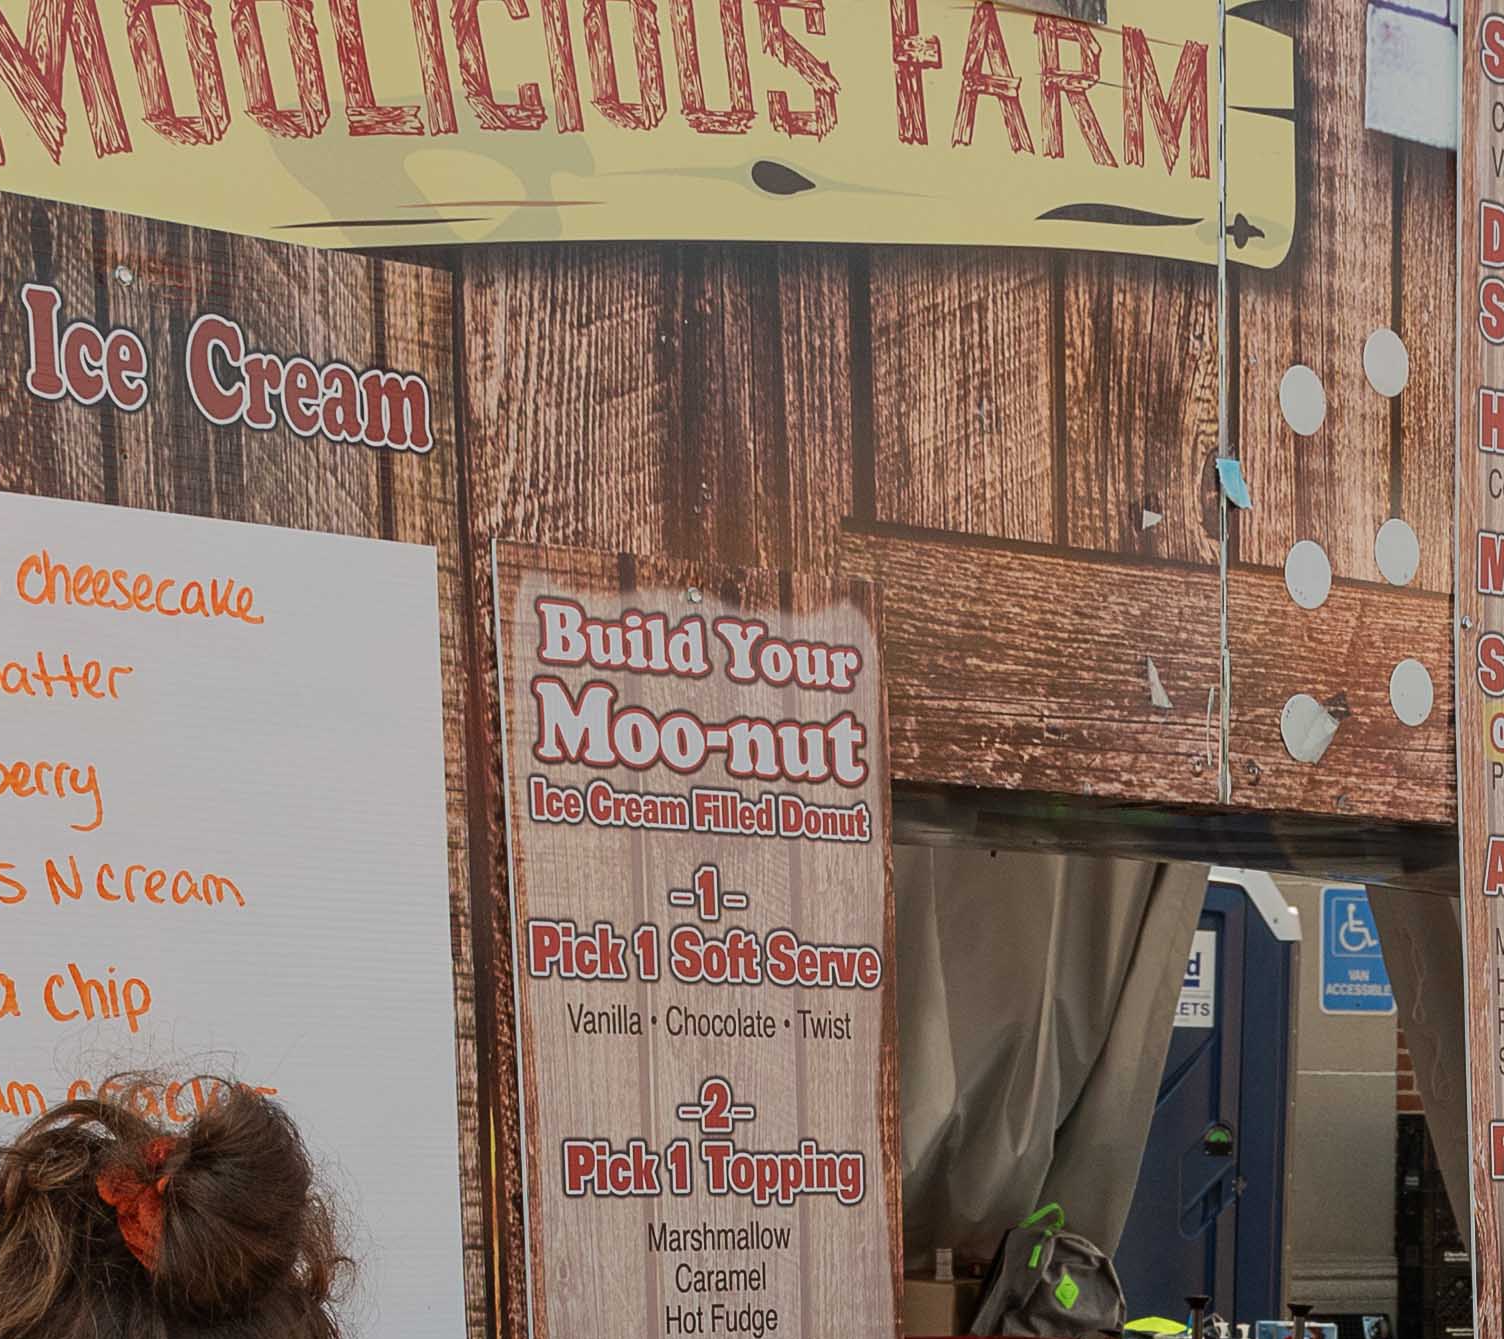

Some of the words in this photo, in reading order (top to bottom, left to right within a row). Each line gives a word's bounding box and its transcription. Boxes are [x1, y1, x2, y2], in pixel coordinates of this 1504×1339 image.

[898, 0, 1211, 179] FARM
[21, 283, 147, 411] Ice
[186, 314, 433, 454] Cream
[536, 595, 707, 677] Build
[717, 618, 861, 692] Your
[532, 676, 868, 788] Moo-nut
[529, 777, 581, 822] Ice
[588, 777, 689, 830] Cream
[692, 788, 776, 837] Filled
[781, 794, 871, 843] Donut
[47, 856, 83, 899] N
[95, 864, 245, 909] cream
[528, 921, 627, 979] Pick
[634, 926, 659, 980] 1
[671, 925, 761, 984] Soft
[767, 931, 881, 989] Serve
[1349, 970, 1369, 981] VAN
[45, 963, 152, 1032] chip
[1176, 1003, 1210, 1016] ETS
[1326, 984, 1391, 996] ACCESSIBLE
[568, 1003, 643, 1036] Vanilla
[666, 1006, 776, 1039] Chocolate
[798, 1010, 852, 1039] Twist
[563, 1140, 659, 1197] Pick
[668, 1142, 691, 1195] 1
[702, 1140, 864, 1205] Topping
[648, 1223, 791, 1251] Marshmallow
[675, 1263, 767, 1293] Caramel
[667, 1305, 704, 1334] Hot
[711, 1305, 778, 1337] Fudge
